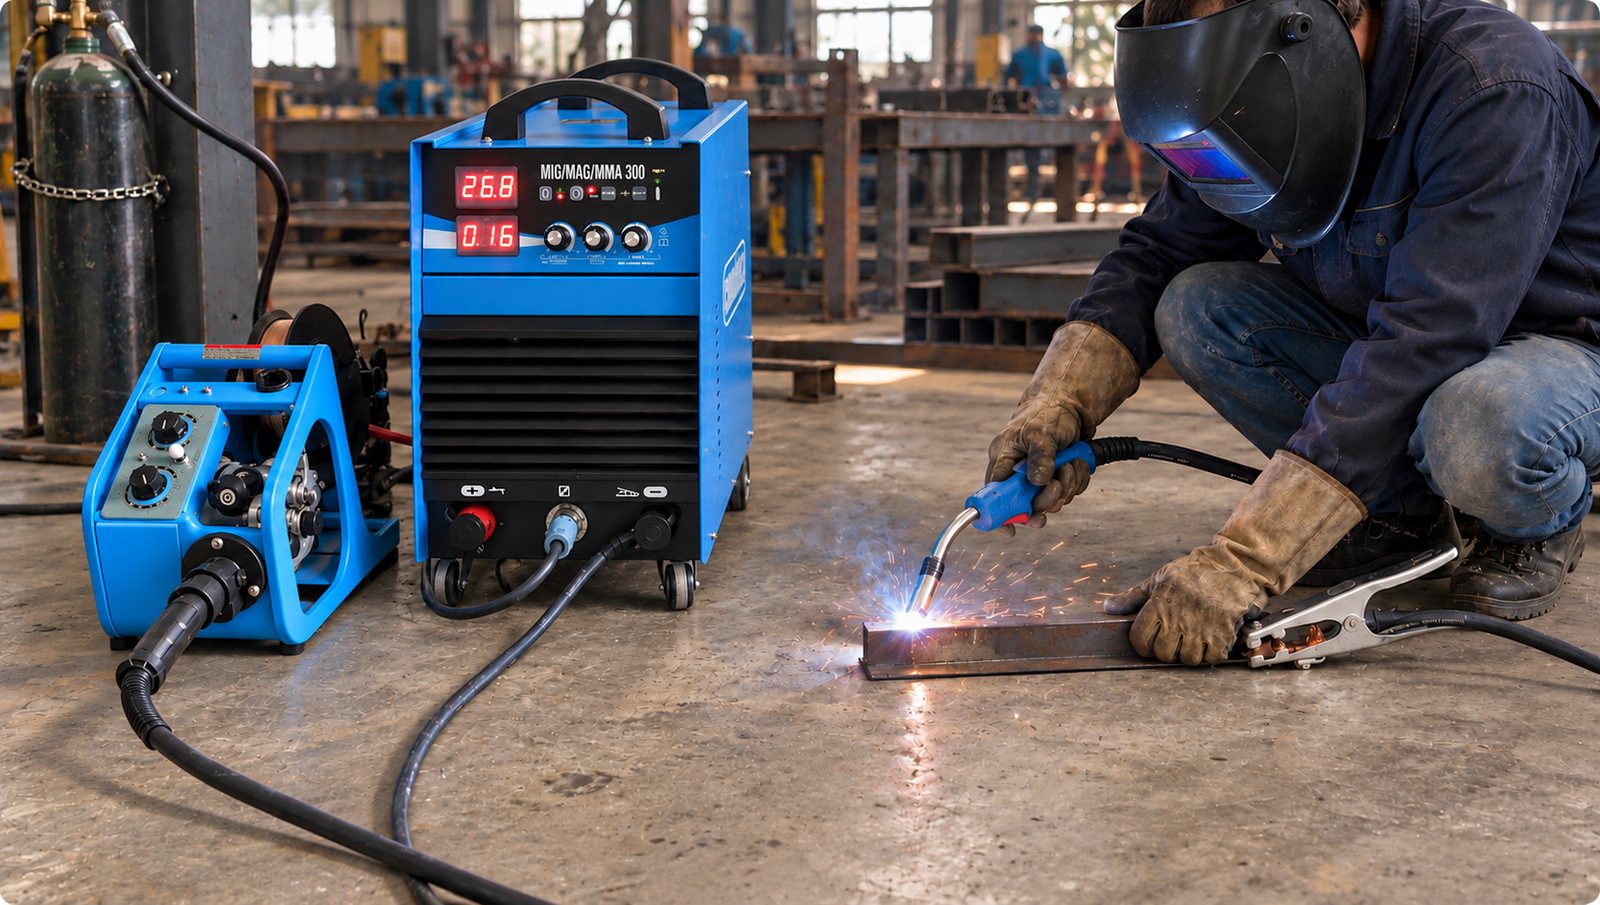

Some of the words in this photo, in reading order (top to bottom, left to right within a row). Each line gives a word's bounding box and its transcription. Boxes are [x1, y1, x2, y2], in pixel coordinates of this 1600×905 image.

[540, 163, 622, 180] MIG/MAG/MMA
[625, 164, 645, 180] 300
[461, 175, 515, 198] 26.8
